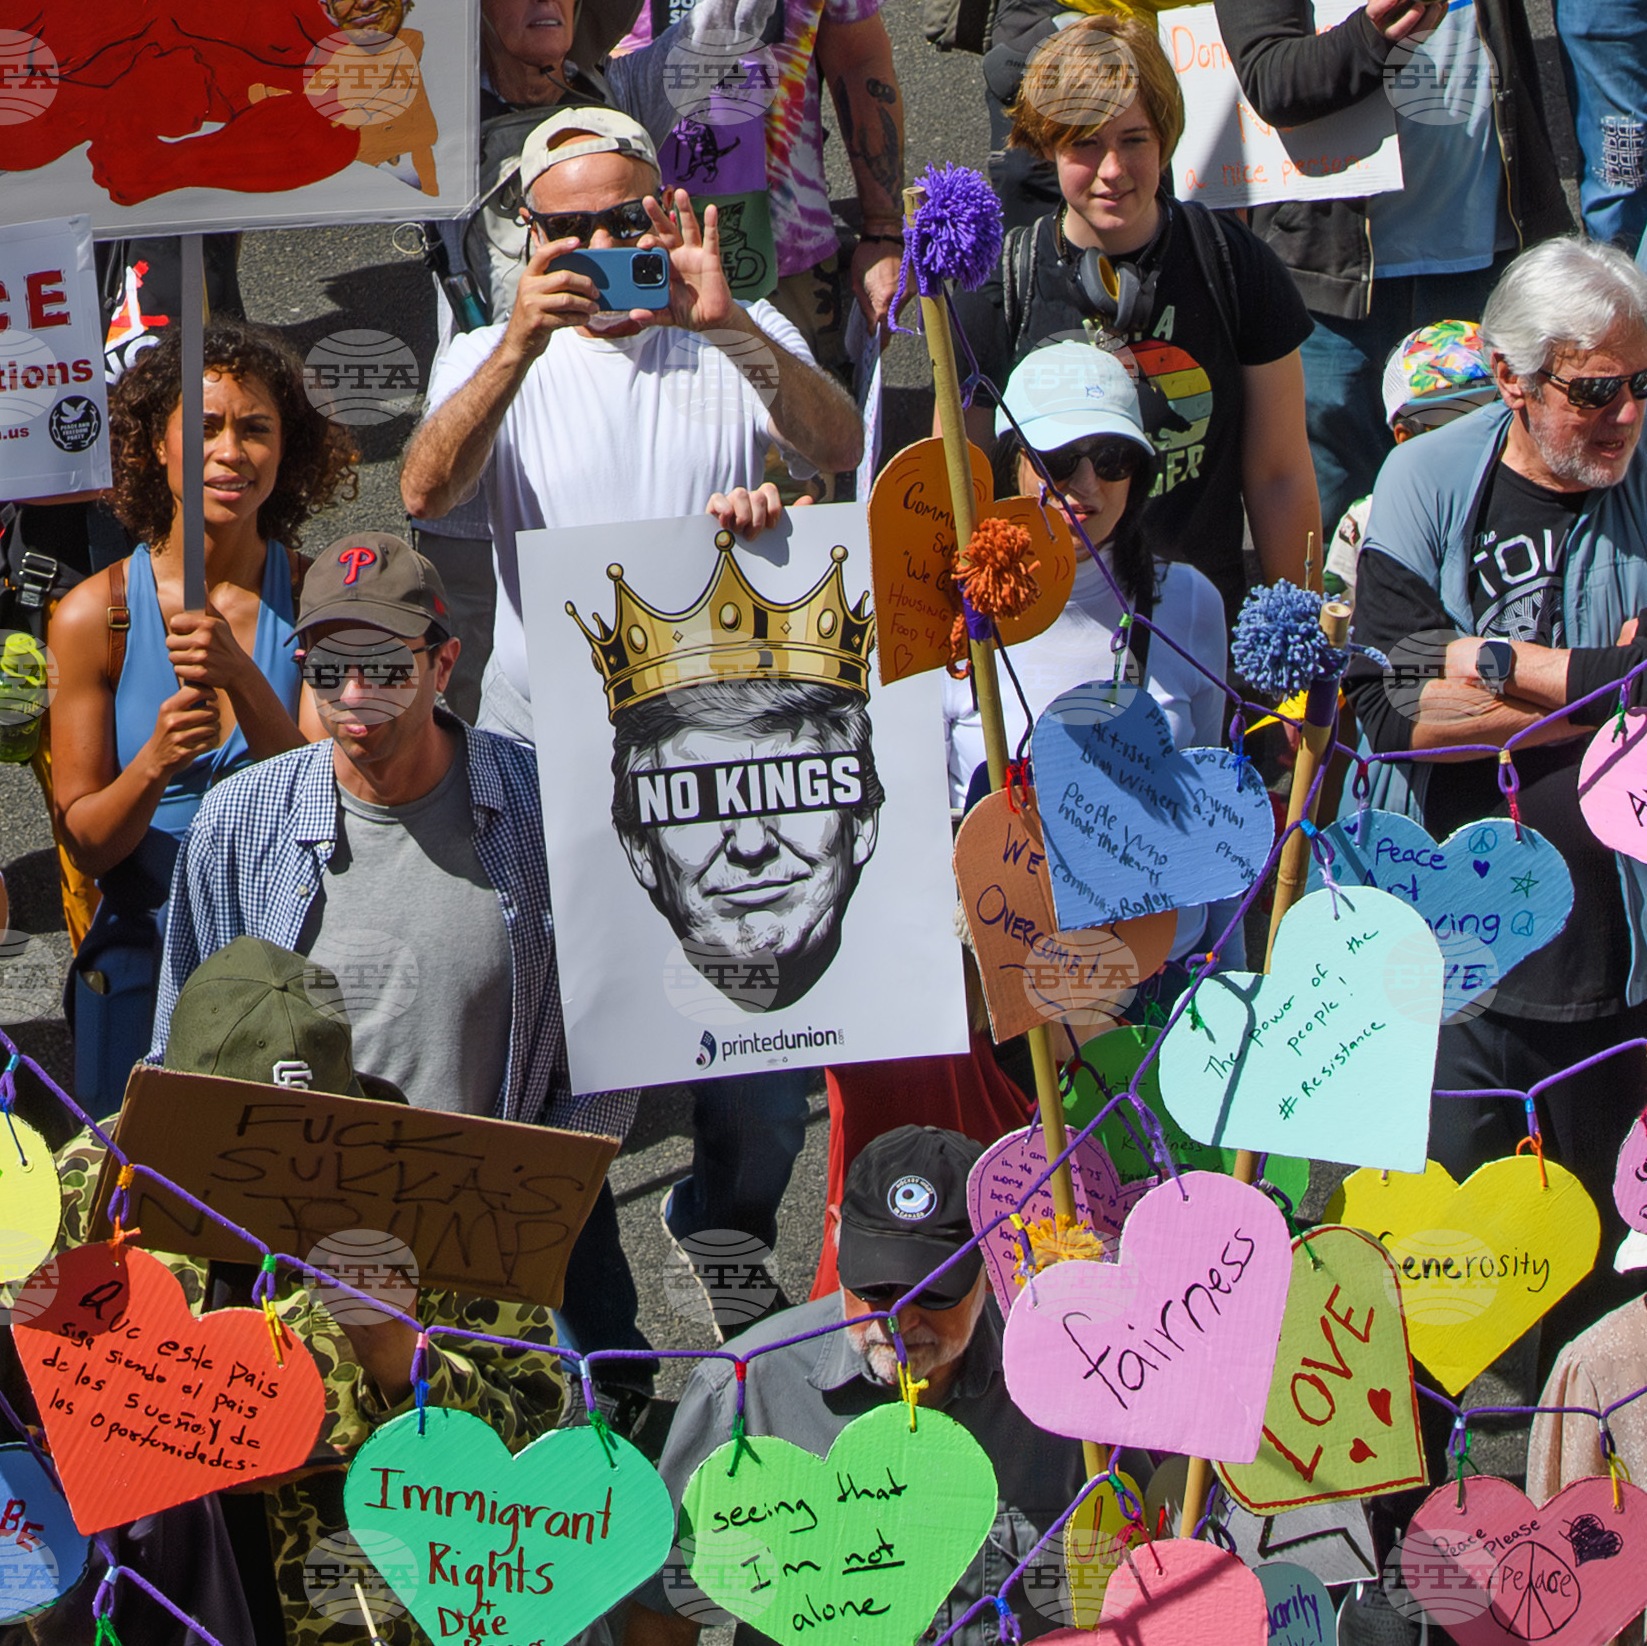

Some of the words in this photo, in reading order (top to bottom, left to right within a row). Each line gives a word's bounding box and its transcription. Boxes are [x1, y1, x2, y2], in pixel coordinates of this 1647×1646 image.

[635, 771, 698, 825] NO
[715, 755, 862, 818] KINGS
[1376, 837, 1447, 872] Peace
[721, 1025, 837, 1061] printedunion
[237, 1104, 485, 1160] FUCK
[1062, 1228, 1257, 1411] fairness
[1263, 1284, 1375, 1485] LOVE
[364, 1466, 613, 1548] Immigrant
[712, 1491, 820, 1536] seeing
[836, 1467, 908, 1504] that
[428, 1542, 556, 1616] Rights
[843, 1529, 898, 1567] not
[792, 1595, 891, 1633] alone
